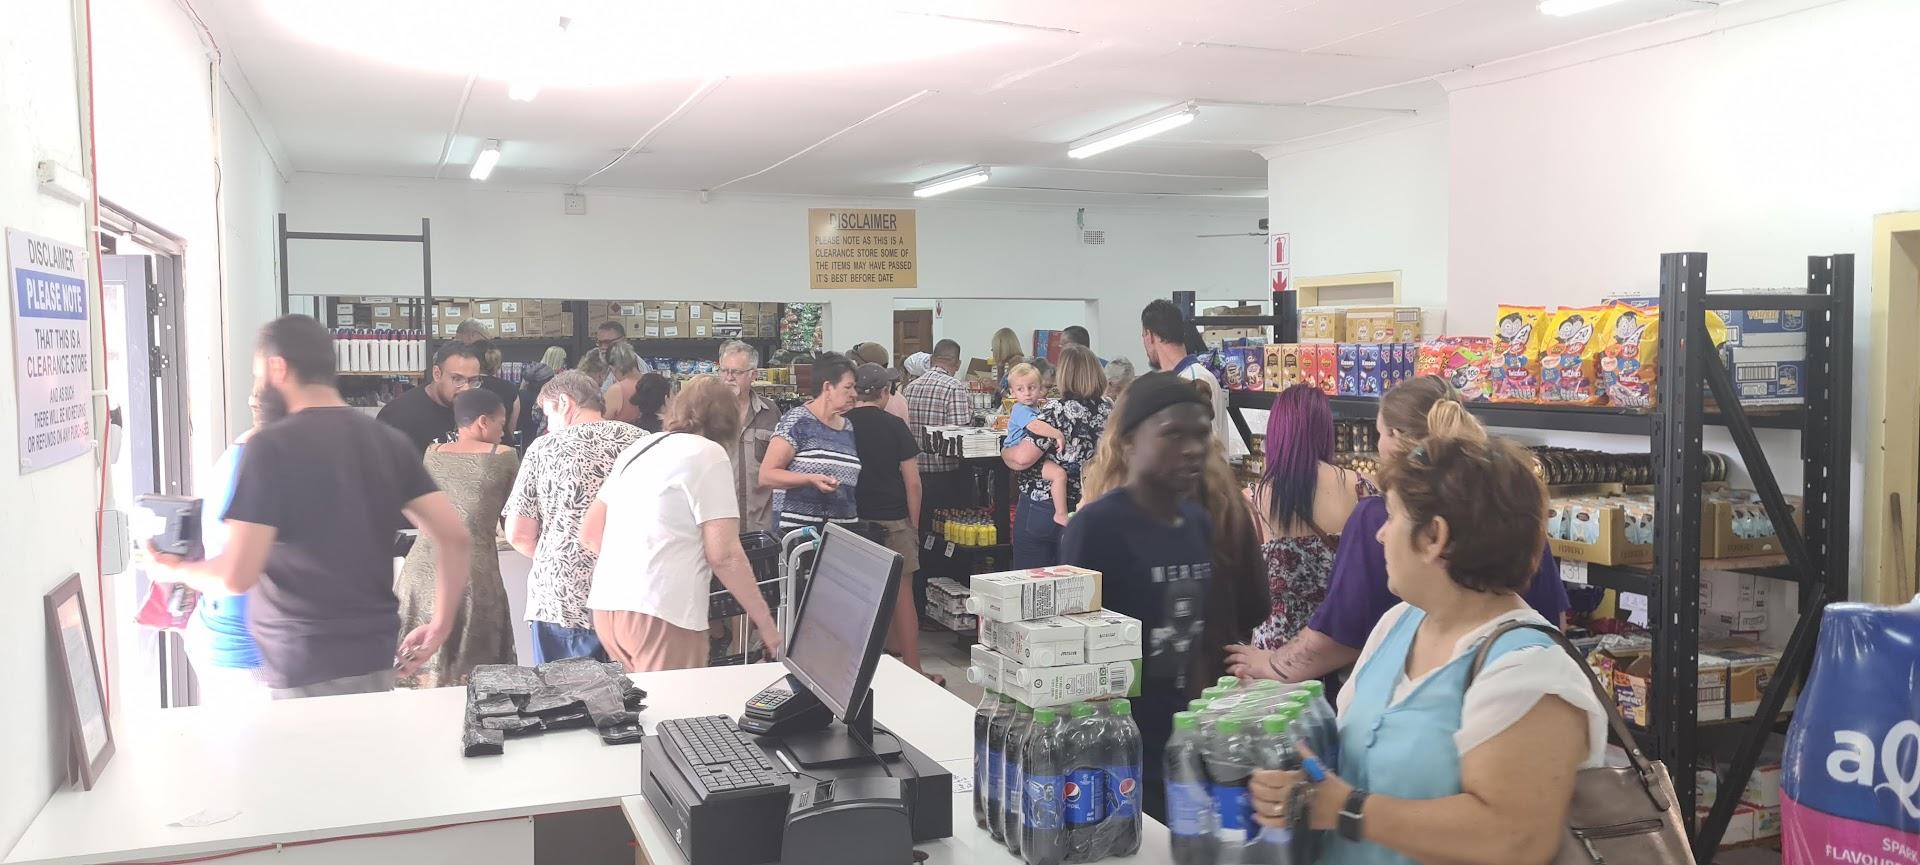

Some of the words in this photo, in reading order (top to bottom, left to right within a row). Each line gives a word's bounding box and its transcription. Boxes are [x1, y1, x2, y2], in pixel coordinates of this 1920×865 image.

[829, 213, 897, 229] DISCLAIMER
[815, 236, 840, 245] PLEASE
[843, 236, 860, 245] NOTE
[862, 236, 872, 245] AS
[874, 236, 888, 245] THIS
[890, 236, 897, 245] IS
[899, 236, 904, 245] A
[28, 238, 75, 272] DISCLAIMER
[815, 248, 855, 258] CLEARANCE
[857, 248, 878, 258] STORE
[880, 248, 898, 258] SOME
[900, 248, 909, 258] OF
[816, 261, 829, 270] THE
[831, 261, 851, 270] ITEMS
[853, 261, 866, 270] MAY
[869, 261, 886, 270] HAVE
[888, 261, 912, 270] PASSED
[831, 274, 848, 282] BEST
[850, 274, 876, 282] BEFORE
[878, 274, 894, 282] DATE
[26, 278, 62, 311] PLEASE
[62, 283, 82, 313] NOTE
[35, 328, 53, 350] THAT
[55, 328, 69, 349] THIS
[70, 329, 76, 349] IS
[27, 354, 69, 378] CLEARANCE
[70, 354, 87, 374] STORE
[50, 387, 58, 403] AND
[59, 386, 65, 402] AS
[65, 385, 74, 401] SUCH
[34, 410, 48, 429] THERE
[50, 408, 59, 425] WILL
[60, 407, 65, 422] BE
[66, 406, 71, 421] NO
[71, 403, 86, 419] RETURNS
[28, 436, 36, 453] OR
[36, 430, 56, 451] REFUNDS
[57, 429, 63, 445] ON
[63, 427, 71, 443] ANY
[1825, 844, 1901, 865] FLAVOUR
